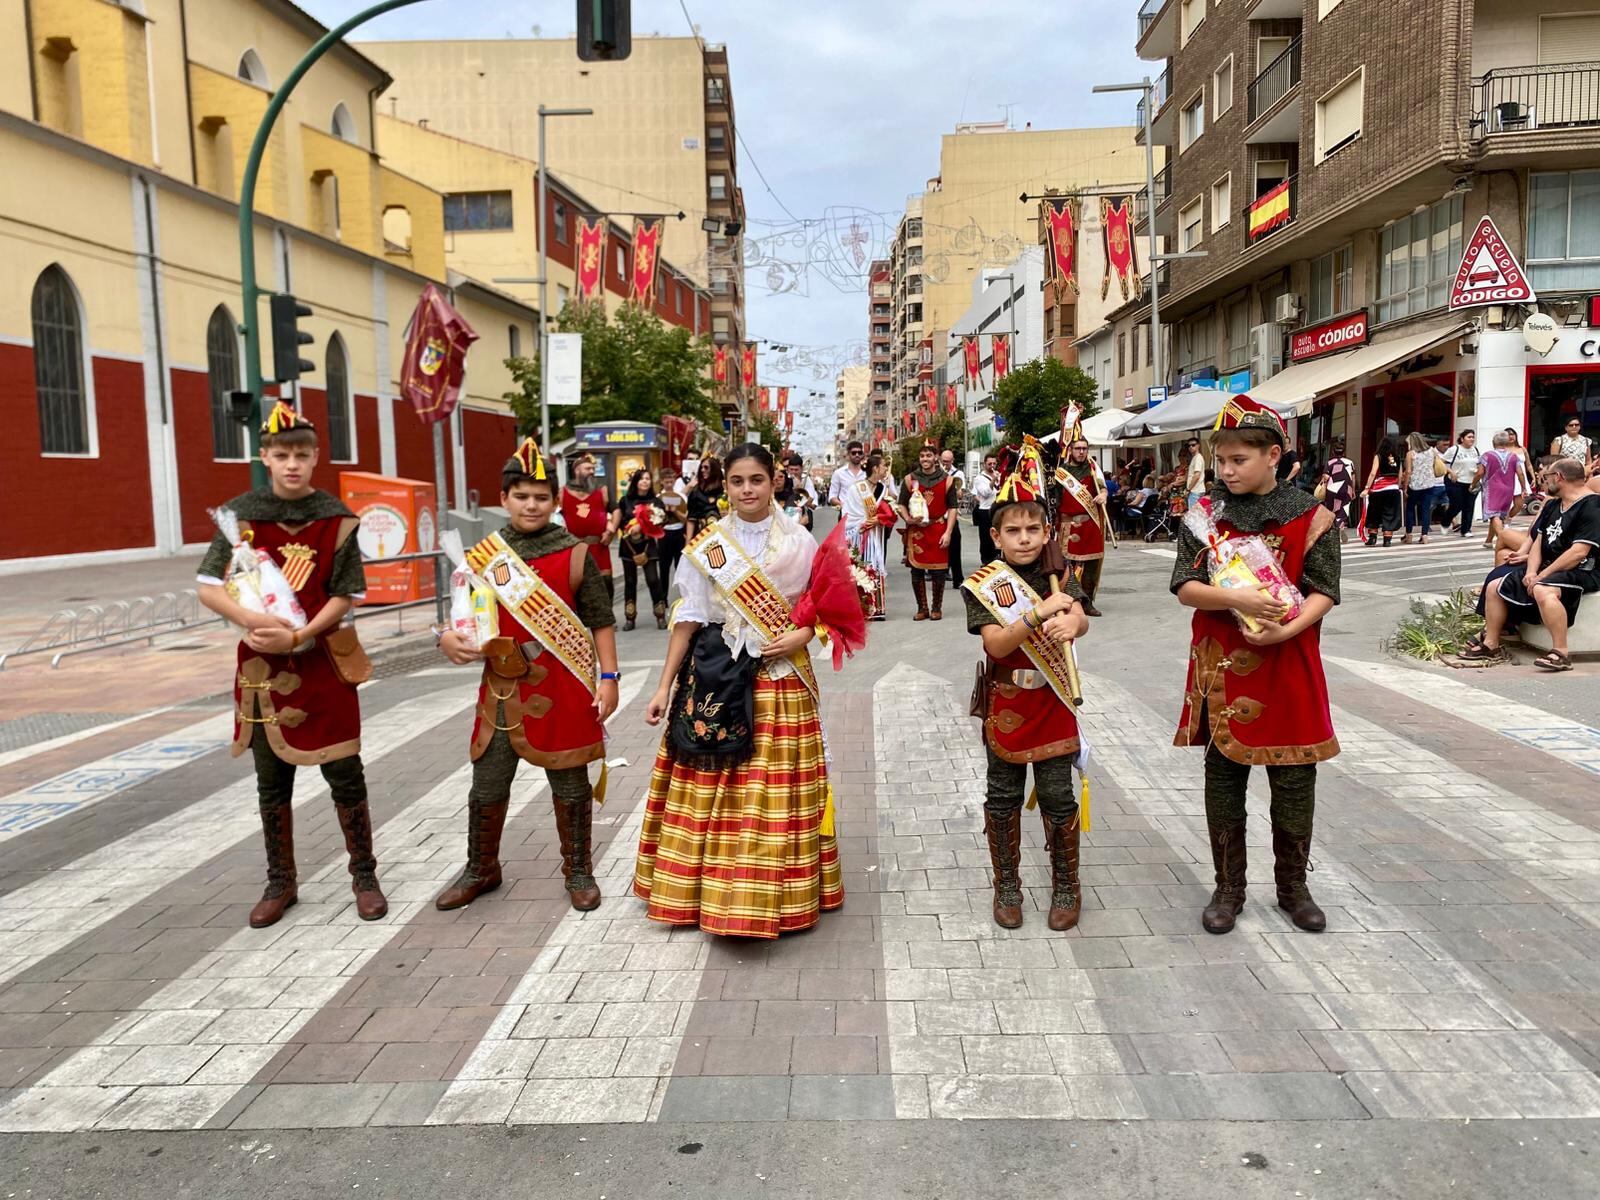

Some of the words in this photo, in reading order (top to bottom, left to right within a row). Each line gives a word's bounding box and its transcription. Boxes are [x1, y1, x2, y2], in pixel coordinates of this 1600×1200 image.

[1453, 287, 1524, 305] CÓDIGO
[1528, 322, 1553, 331] Televés
[1298, 335, 1312, 347] auto
[1318, 322, 1364, 347] CÓDIGO
[1293, 342, 1316, 356] escuela
[1580, 340, 1600, 357] C
